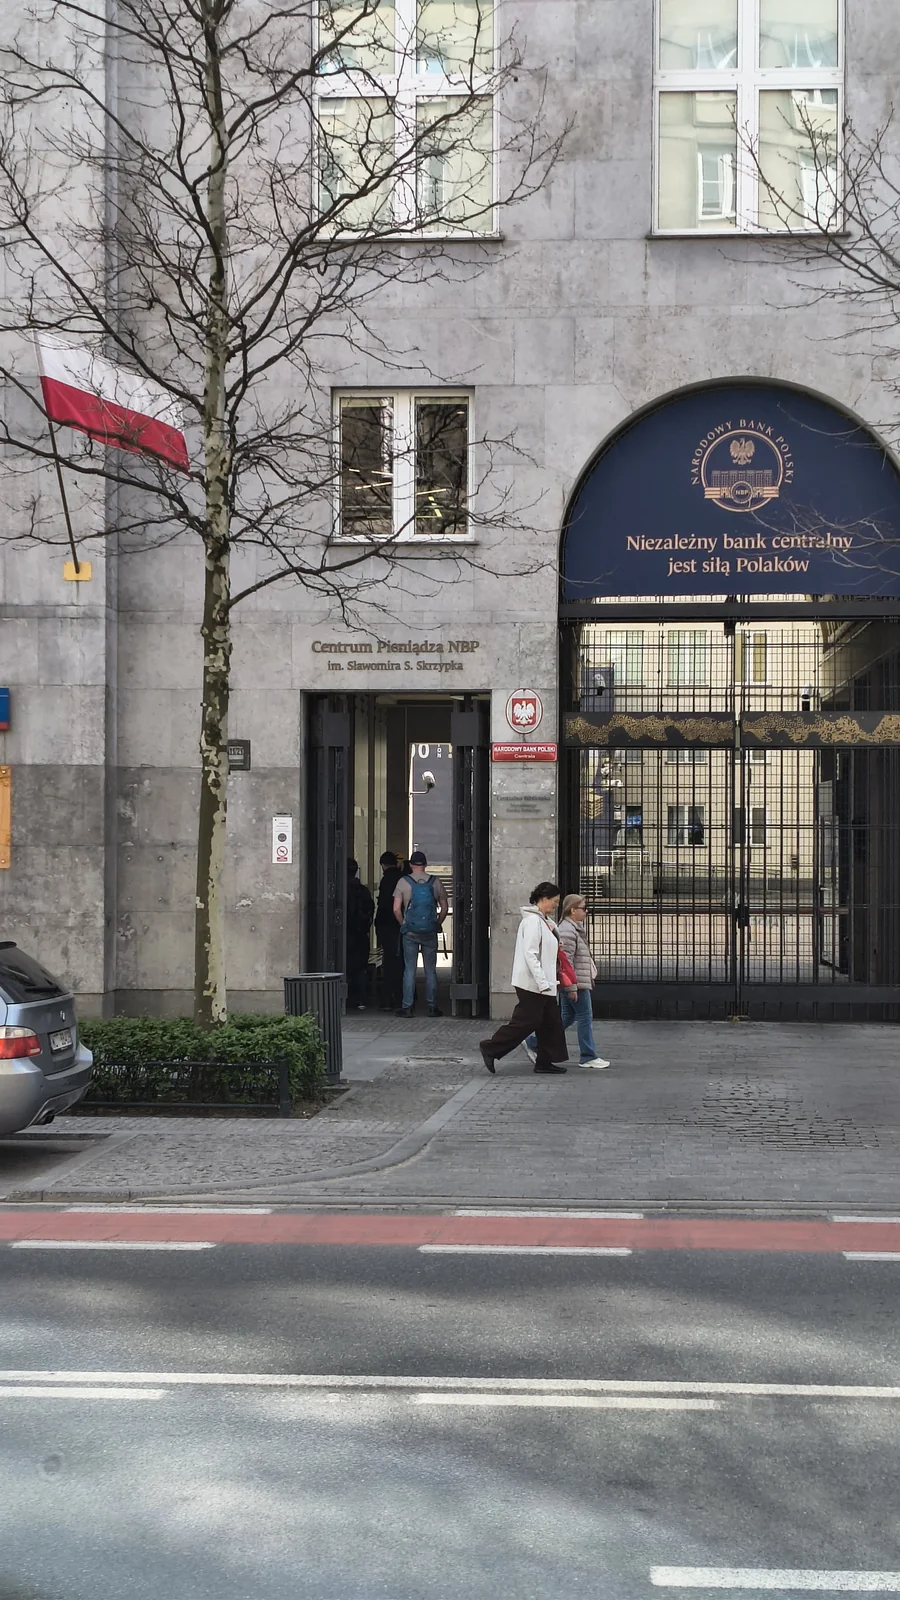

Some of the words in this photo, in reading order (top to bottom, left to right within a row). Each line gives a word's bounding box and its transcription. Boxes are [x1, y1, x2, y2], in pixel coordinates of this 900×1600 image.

[691, 420, 732, 485] NARODOWY
[739, 419, 774, 436] BANK
[775, 436, 794, 484] POLSKI
[626, 533, 718, 553] Niezależny
[723, 533, 767, 550] bank
[771, 532, 853, 552] centralny
[667, 557, 697, 577] jest
[702, 556, 730, 577] siłą
[736, 556, 810, 573] Polaków
[311, 640, 373, 654] Centrum
[377, 640, 444, 656] Pieniądza
[448, 640, 480, 654] NBP
[327, 660, 344, 671] im.
[347, 660, 401, 671] Sławomira
[404, 660, 413, 671] S.
[416, 660, 464, 673] Skrzypka
